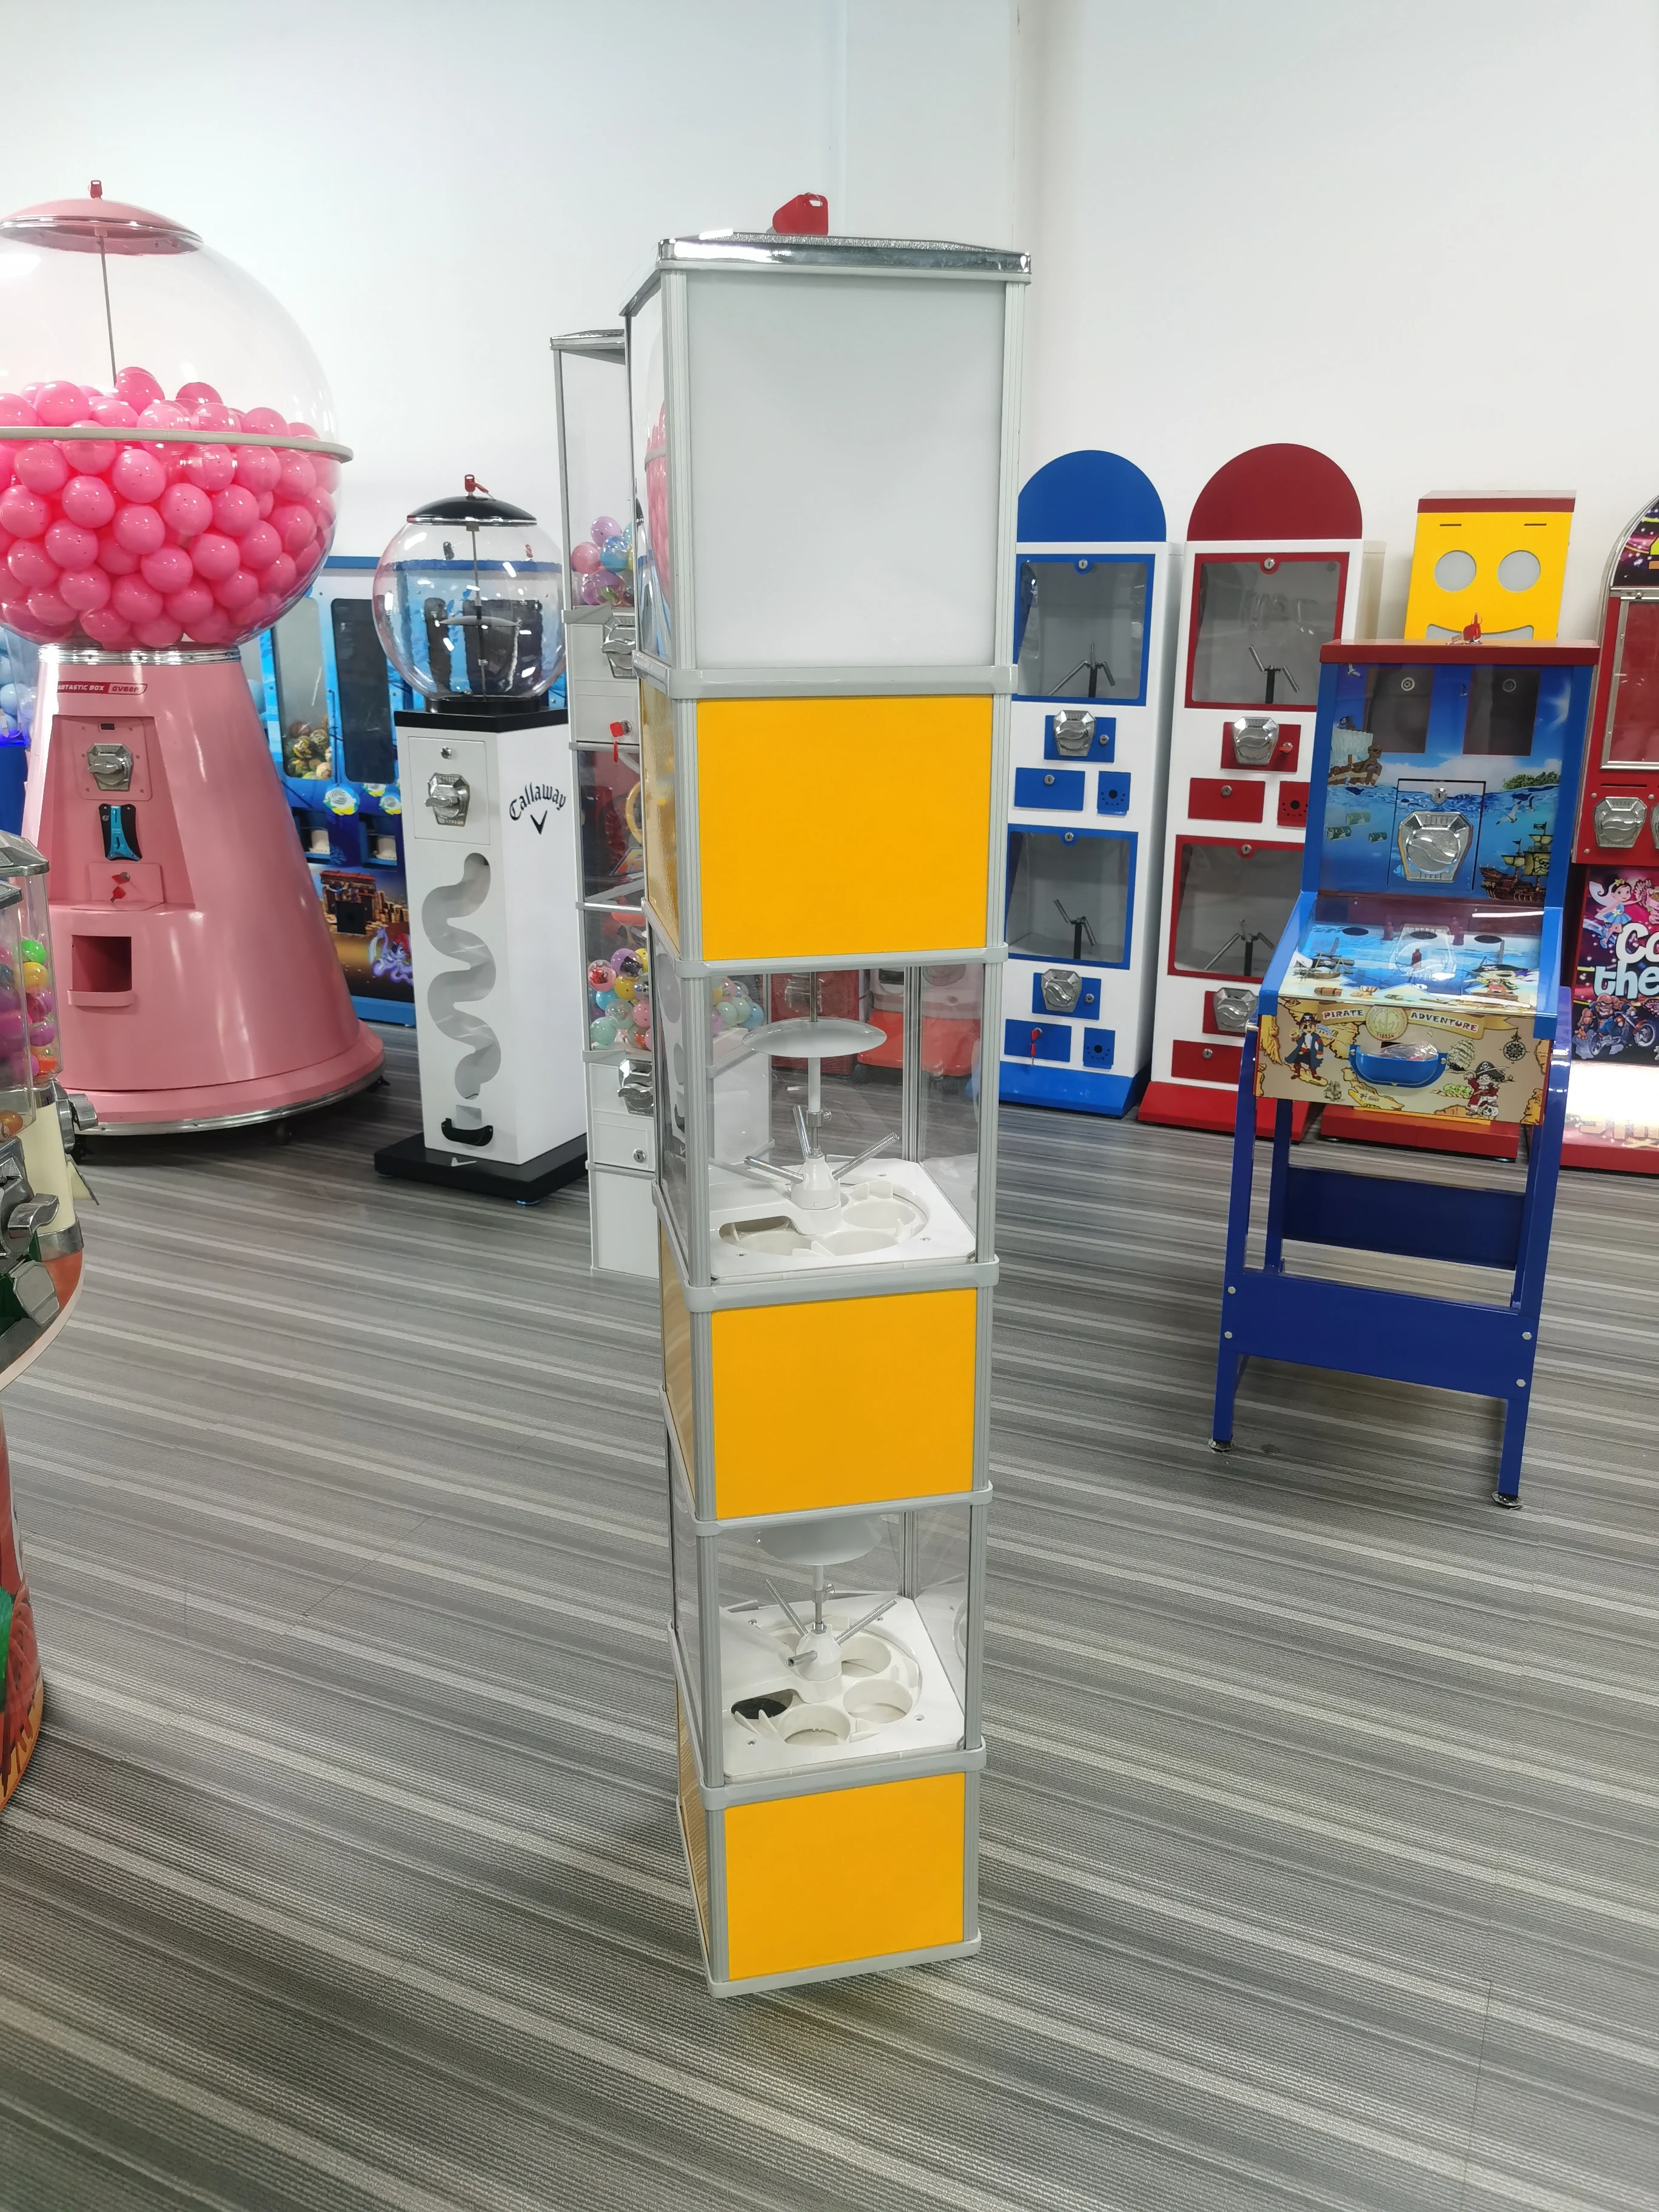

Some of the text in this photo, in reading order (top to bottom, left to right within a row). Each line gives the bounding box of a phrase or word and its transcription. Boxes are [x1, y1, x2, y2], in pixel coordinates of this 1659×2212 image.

[509, 782, 566, 821] Callaway
[1324, 1009, 1364, 1019] PIRATE
[1410, 1011, 1478, 1032] ADVENTURE
